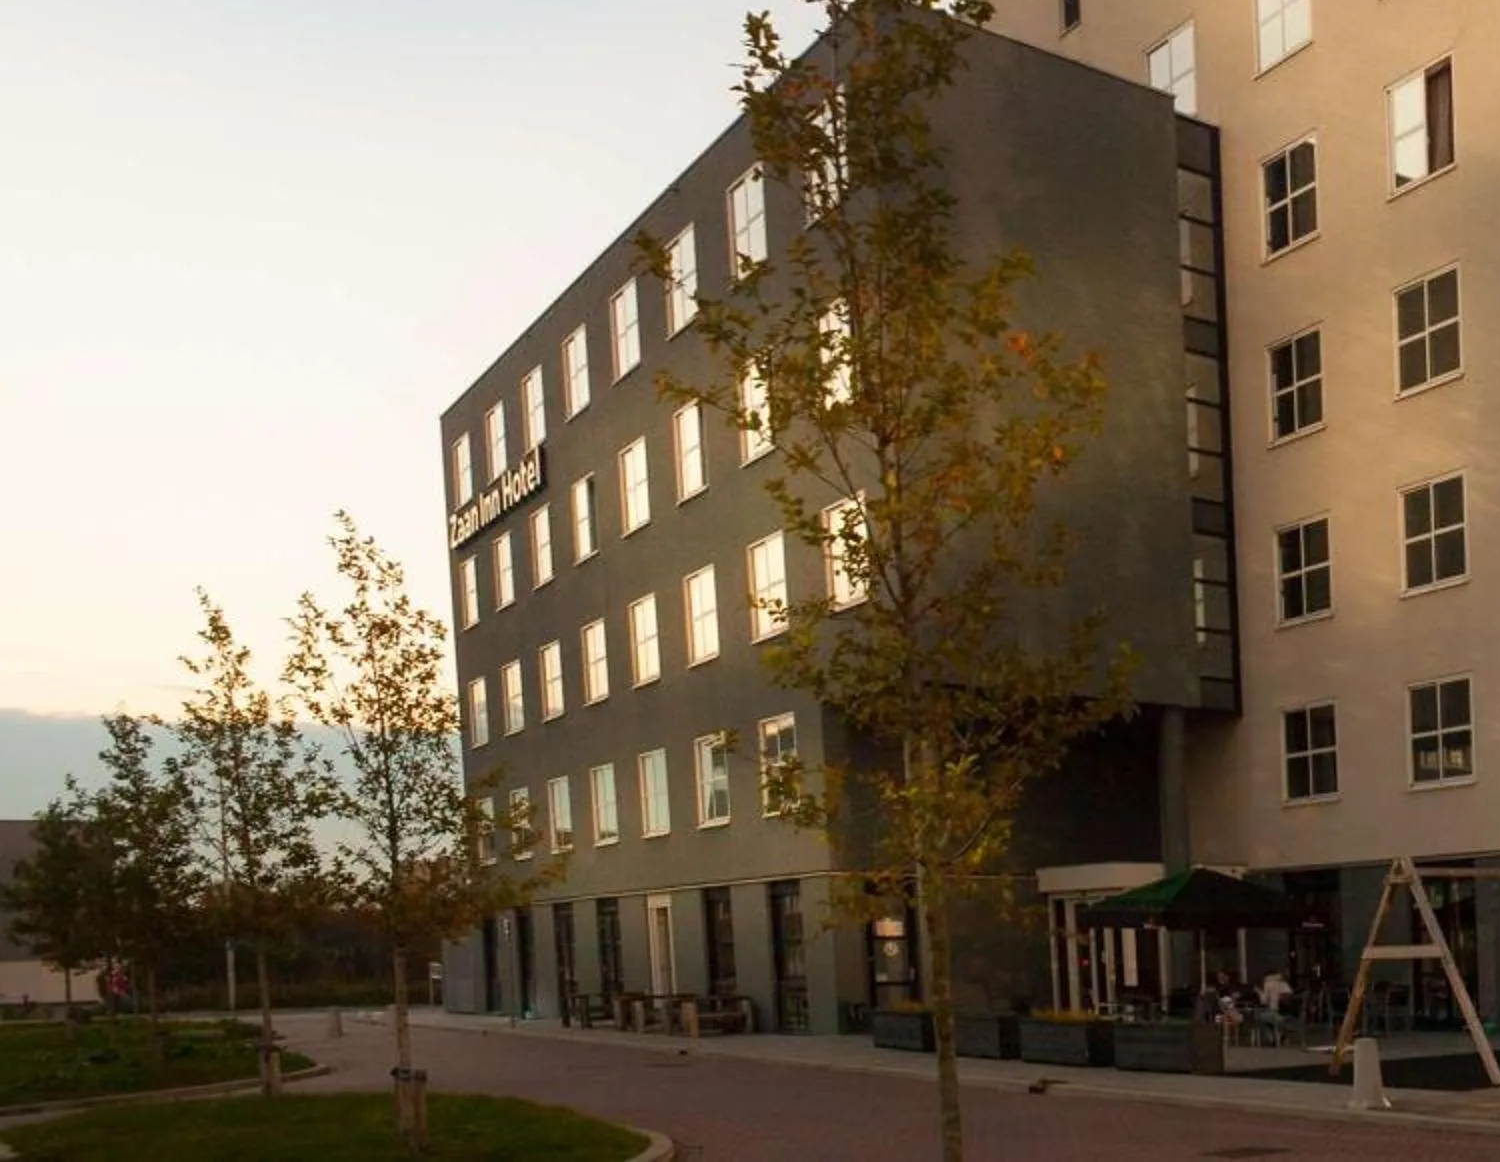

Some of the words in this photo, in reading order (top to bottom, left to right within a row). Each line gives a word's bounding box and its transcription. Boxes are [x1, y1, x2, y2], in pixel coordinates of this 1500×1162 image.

[449, 505, 479, 549] Zaan
[479, 489, 501, 527] Inn
[501, 446, 541, 511] Hotel
